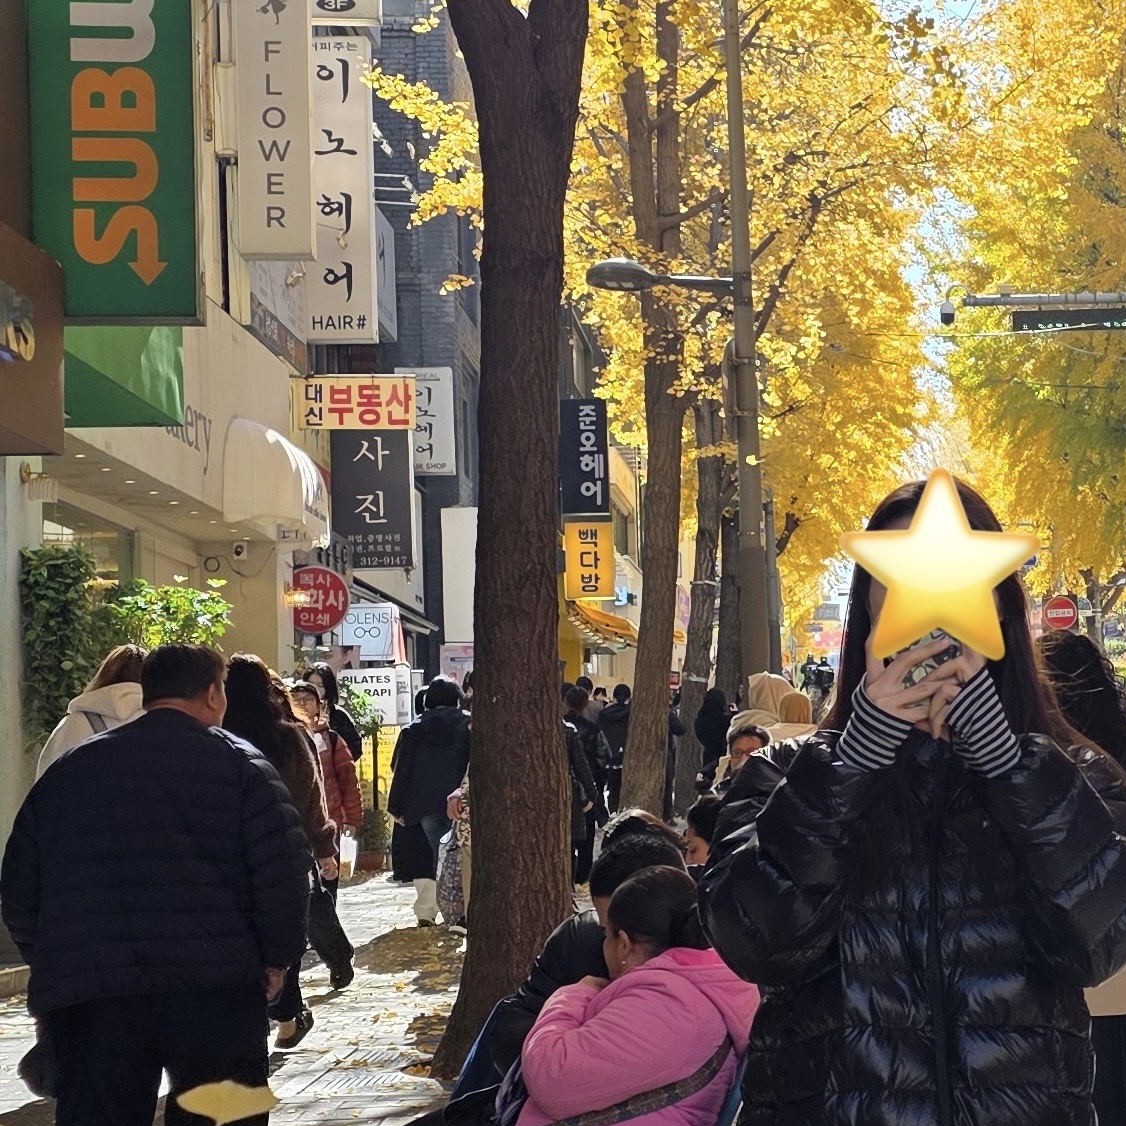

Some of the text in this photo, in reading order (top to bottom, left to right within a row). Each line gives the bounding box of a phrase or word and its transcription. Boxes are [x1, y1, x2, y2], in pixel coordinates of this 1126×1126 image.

[258, 40, 292, 229] FLOWER
[304, 384, 323, 427] 대신
[328, 383, 412, 426] 부동산
[579, 405, 604, 506] 준오헤어
[353, 436, 390, 524] 사진
[360, 556, 407, 566] 312-9147
[298, 587, 345, 611] 화사
[299, 612, 331, 627] 인쇄
[344, 612, 390, 625] OLENS
[342, 675, 391, 685] PILATES
[364, 688, 392, 697] RAPI
